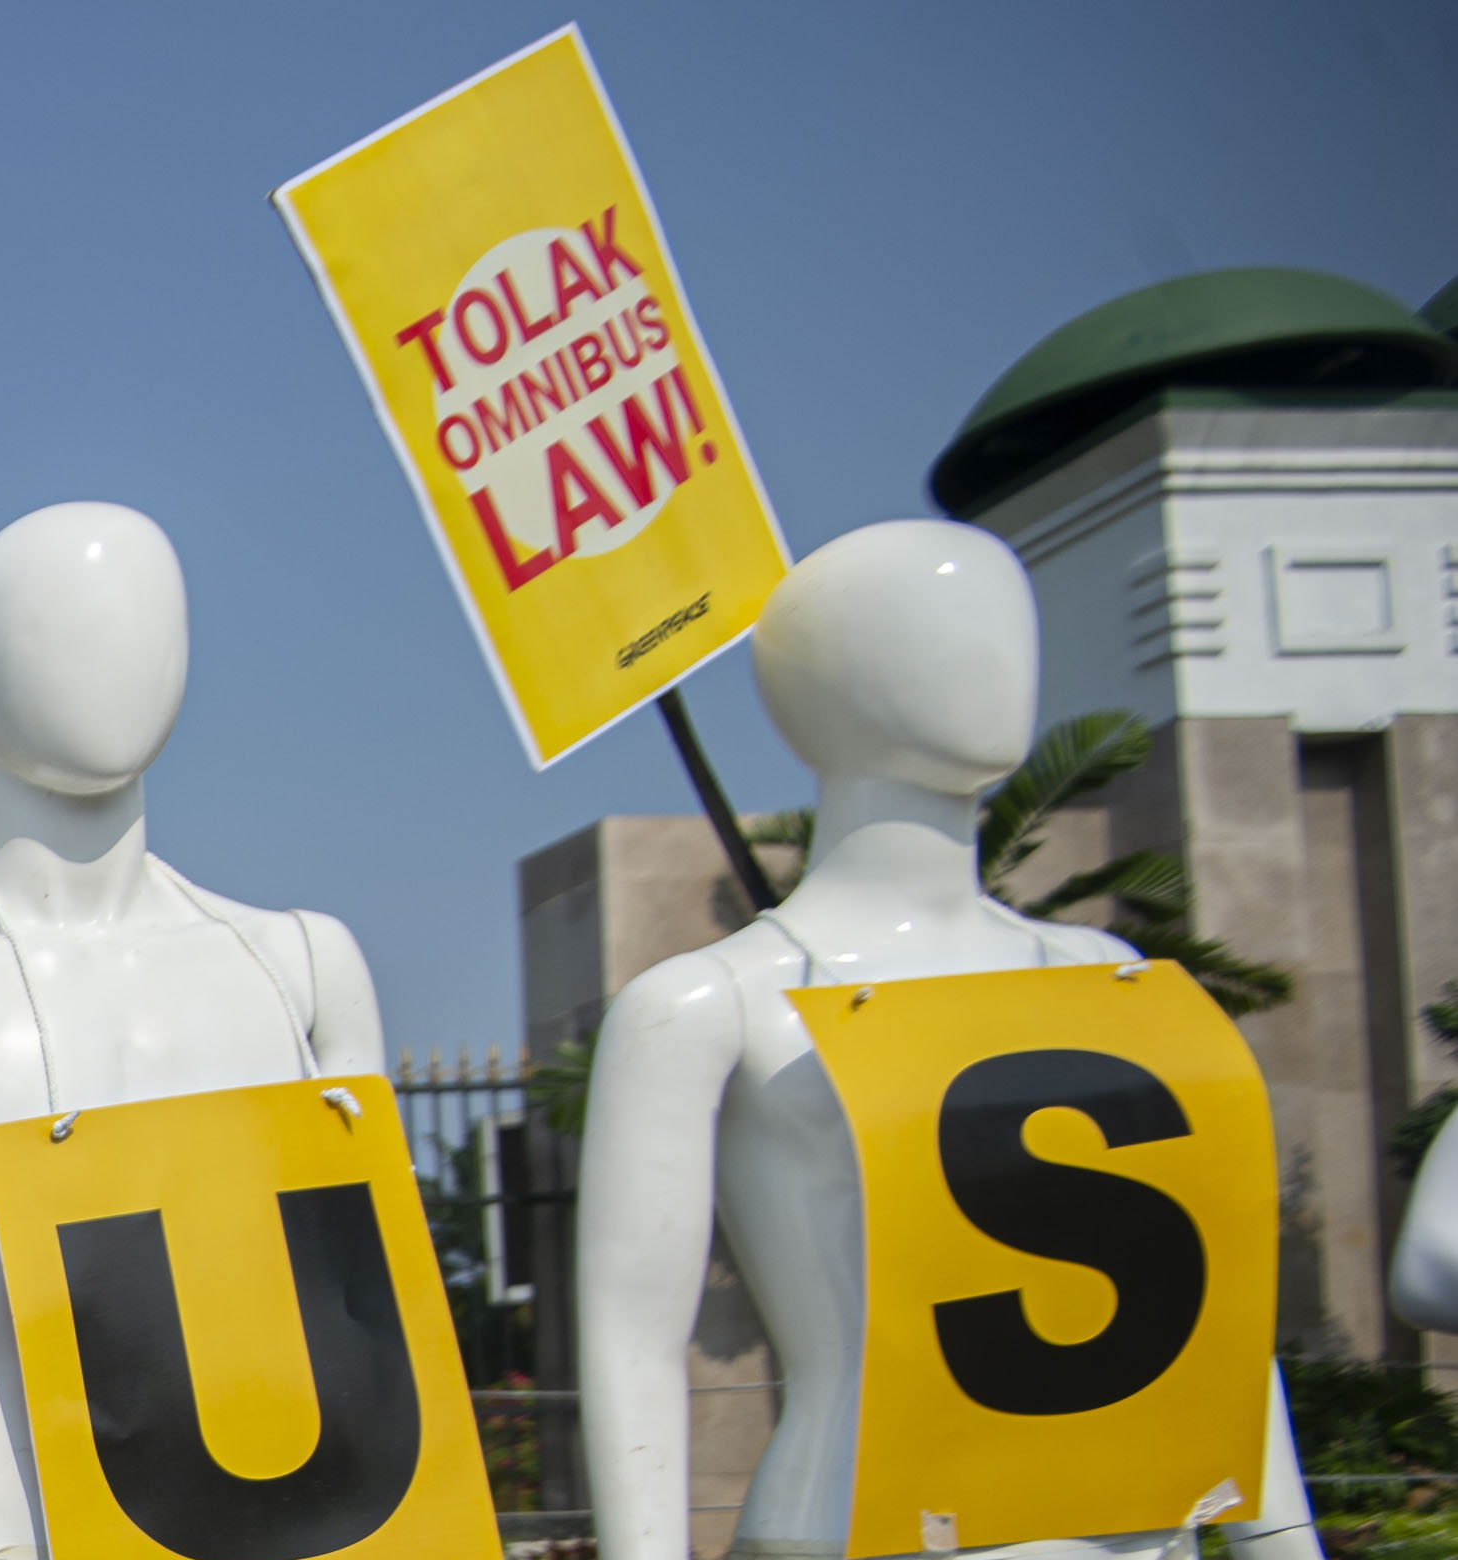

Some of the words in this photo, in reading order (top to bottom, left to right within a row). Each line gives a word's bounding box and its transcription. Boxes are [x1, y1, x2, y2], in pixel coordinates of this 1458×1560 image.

[395, 205, 645, 392] TOLAK
[436, 296, 671, 472] OMNIBUS
[469, 364, 719, 594] LAW!
[932, 1049, 1207, 1416] S
